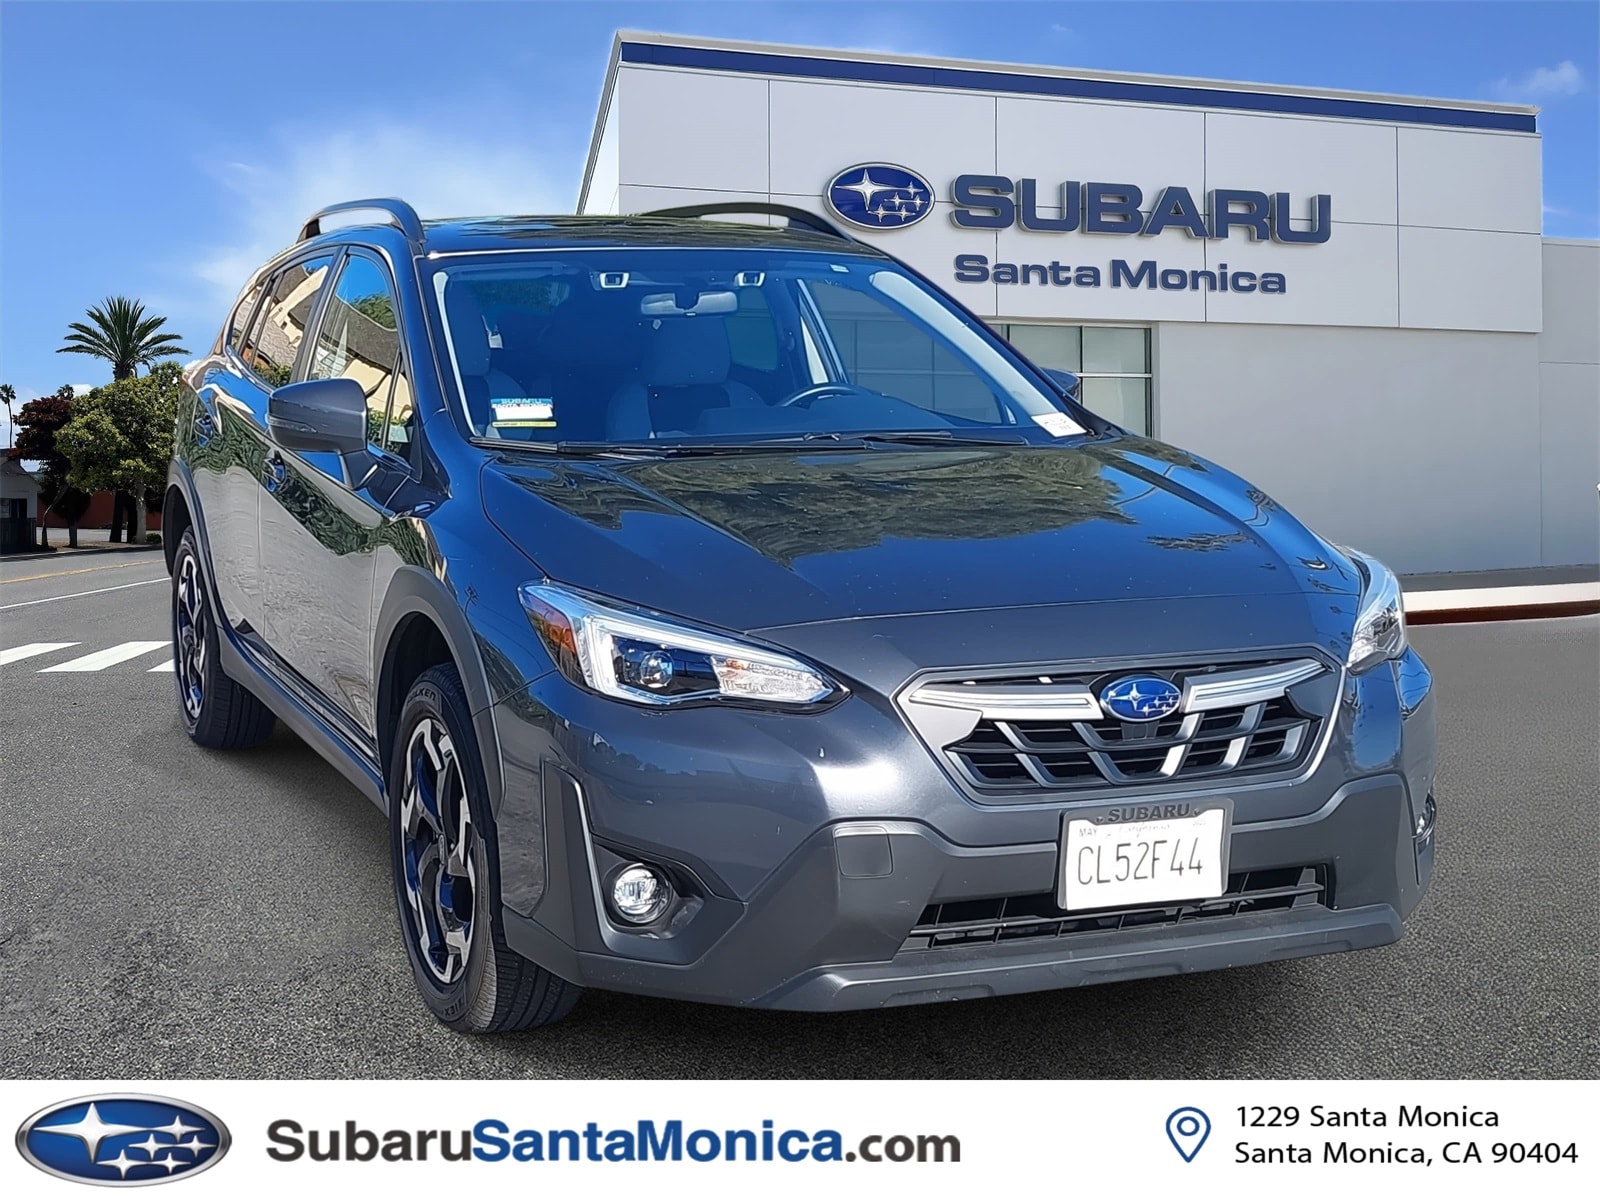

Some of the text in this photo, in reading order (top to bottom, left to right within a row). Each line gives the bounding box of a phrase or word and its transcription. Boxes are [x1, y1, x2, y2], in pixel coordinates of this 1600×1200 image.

[951, 174, 1332, 243] SUBARU
[954, 254, 1287, 293] Santa Monica
[1079, 827, 1098, 837] MAY
[1108, 803, 1190, 822] SUBARU
[1078, 838, 1203, 885] CL52F44
